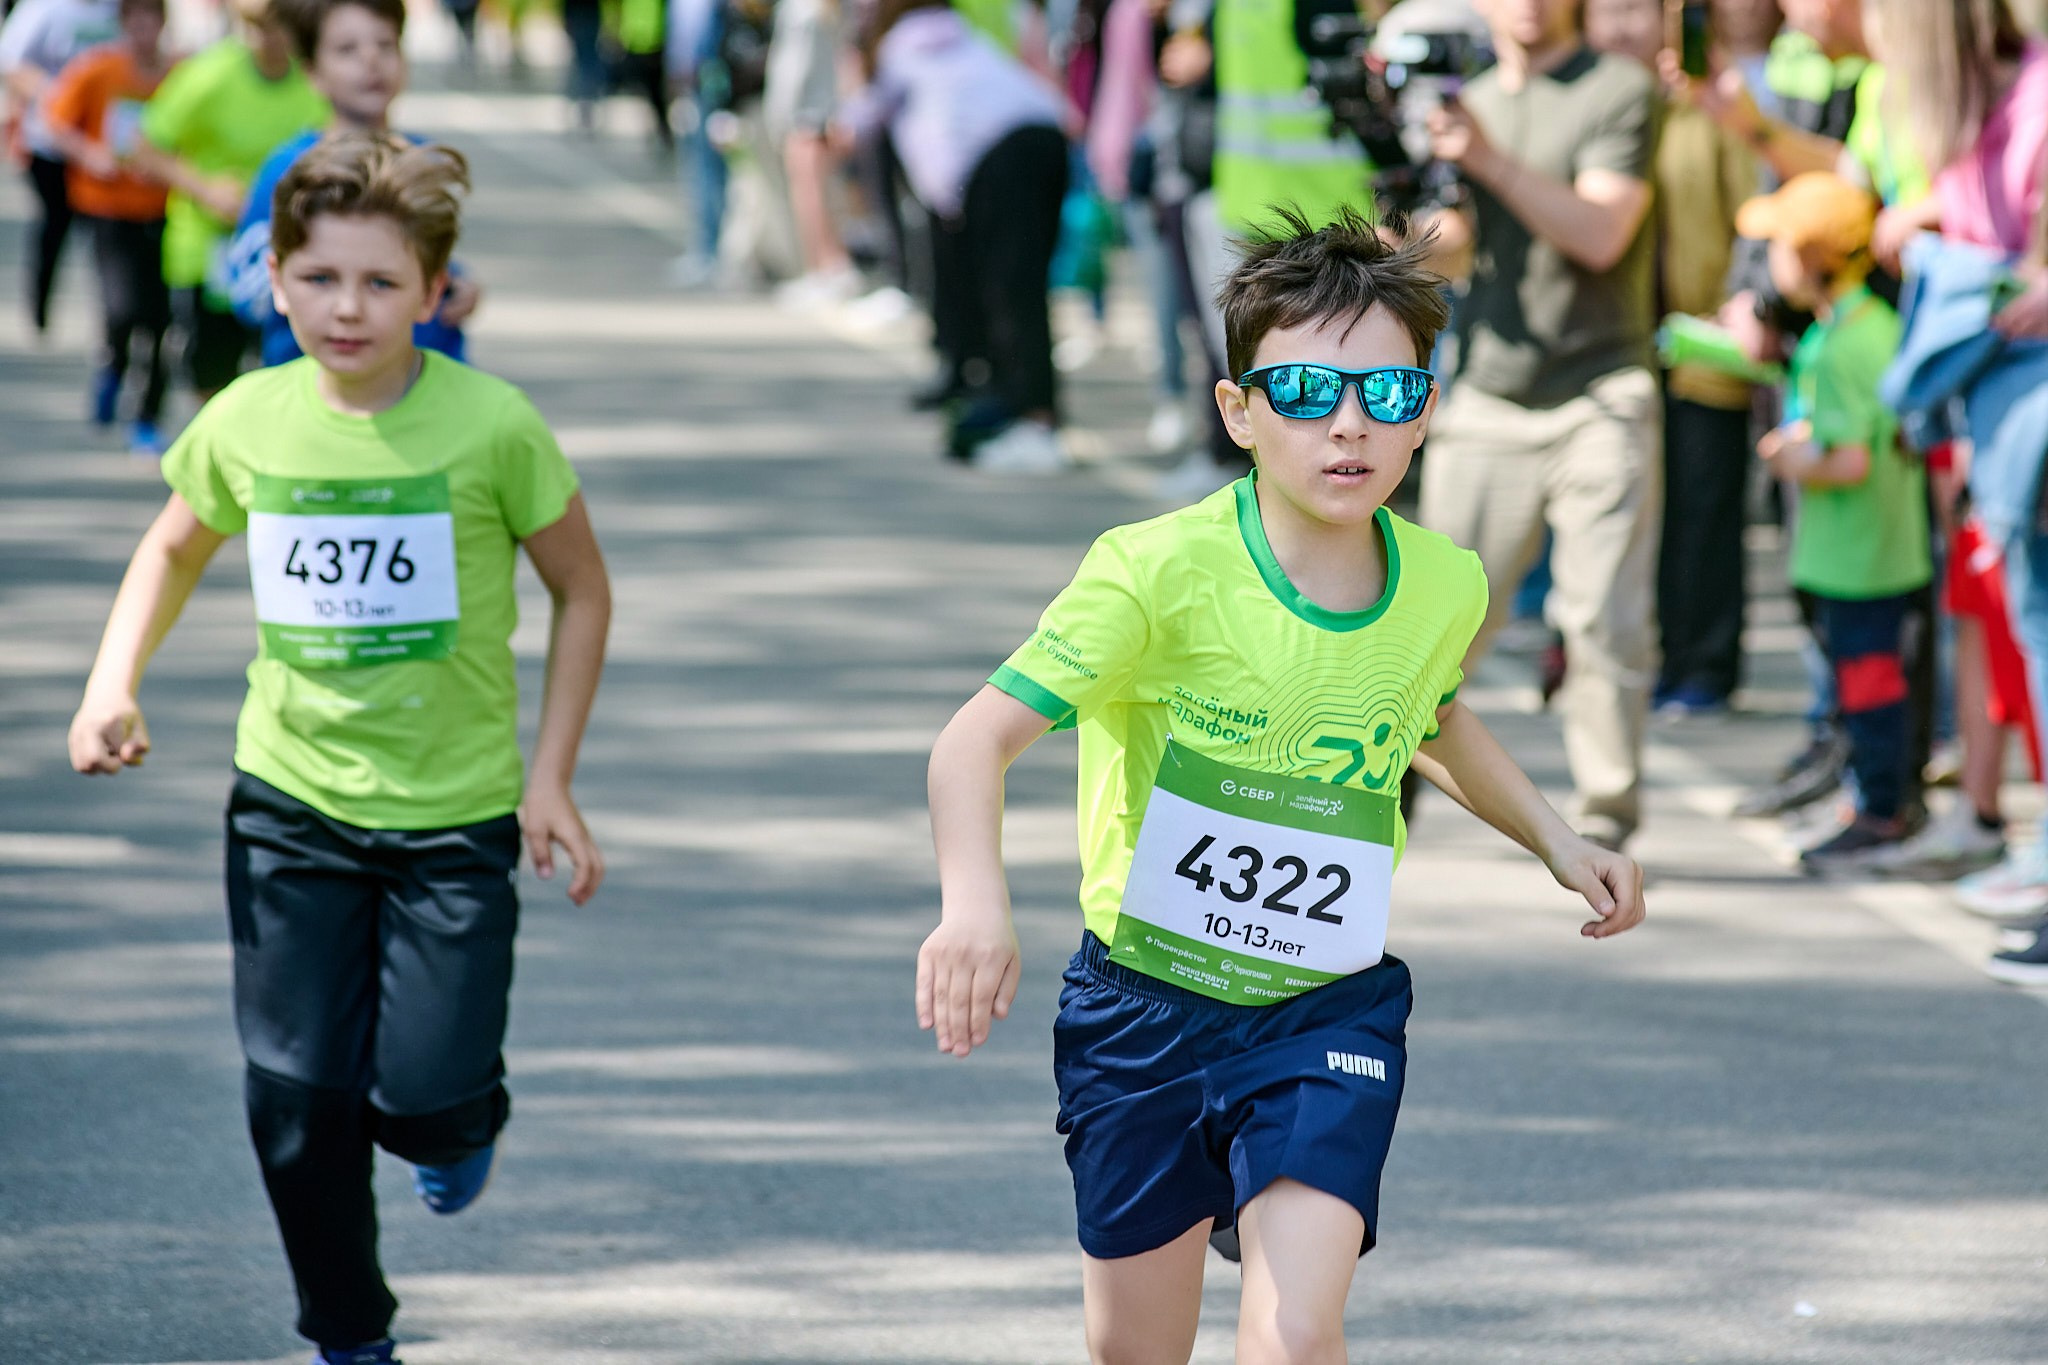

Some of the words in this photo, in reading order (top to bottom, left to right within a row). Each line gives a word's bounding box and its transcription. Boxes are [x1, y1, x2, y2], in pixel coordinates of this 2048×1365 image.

[285, 538, 415, 584] 4376
[1037, 640, 1045, 649] в
[1047, 644, 1098, 680] будущее
[1045, 629, 1082, 658] Вклад
[1157, 697, 1252, 745] марафон
[1174, 686, 1268, 729] зелёный
[1239, 786, 1275, 801] СБЕР
[1289, 801, 1324, 812] марафон
[1295, 794, 1328, 806] зелёный
[1175, 834, 1351, 925] 4322
[1153, 939, 1207, 964] Перекрёсток
[1204, 913, 1270, 948] 10-13
[1269, 939, 1306, 957] лет
[1326, 1050, 1386, 1082] PUMA
